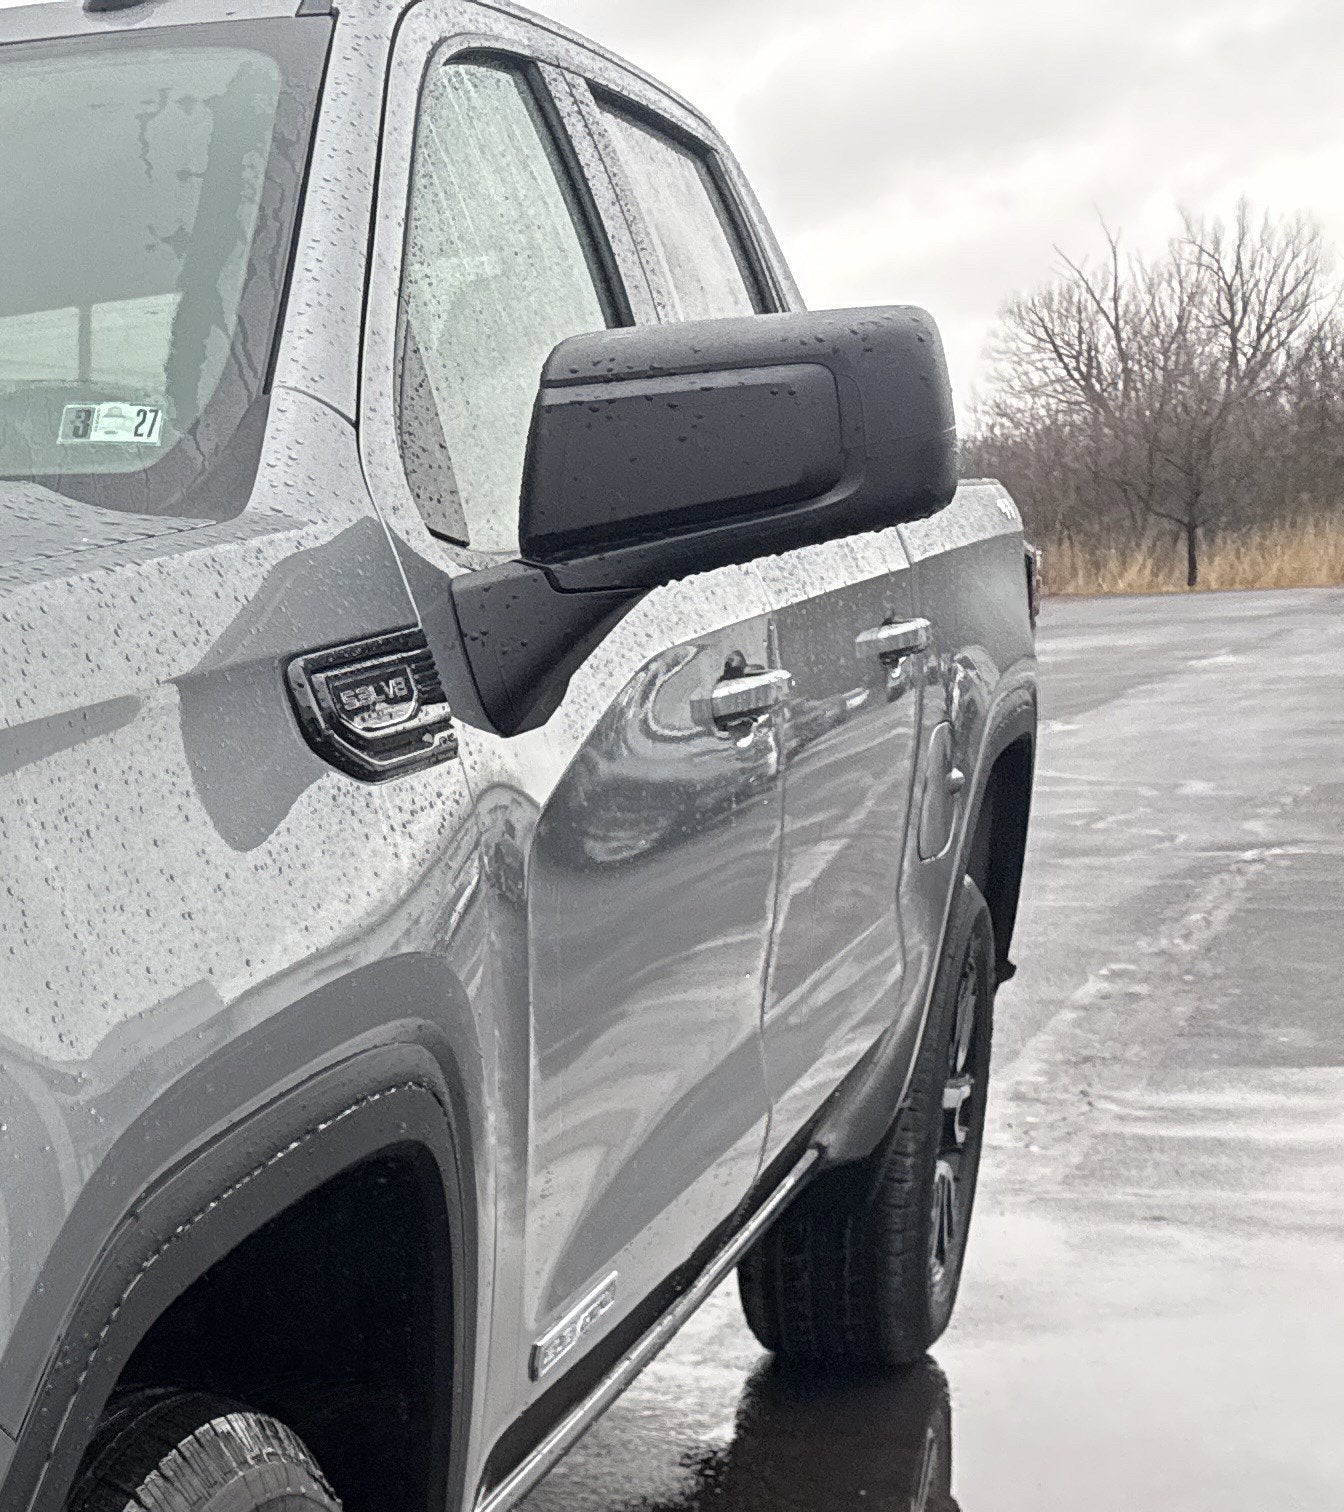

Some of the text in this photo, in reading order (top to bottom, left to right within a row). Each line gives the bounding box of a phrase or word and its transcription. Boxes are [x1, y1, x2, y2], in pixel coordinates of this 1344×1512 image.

[72, 408, 92, 438] 3
[133, 408, 159, 439] 27
[379, 677, 408, 698] V8
